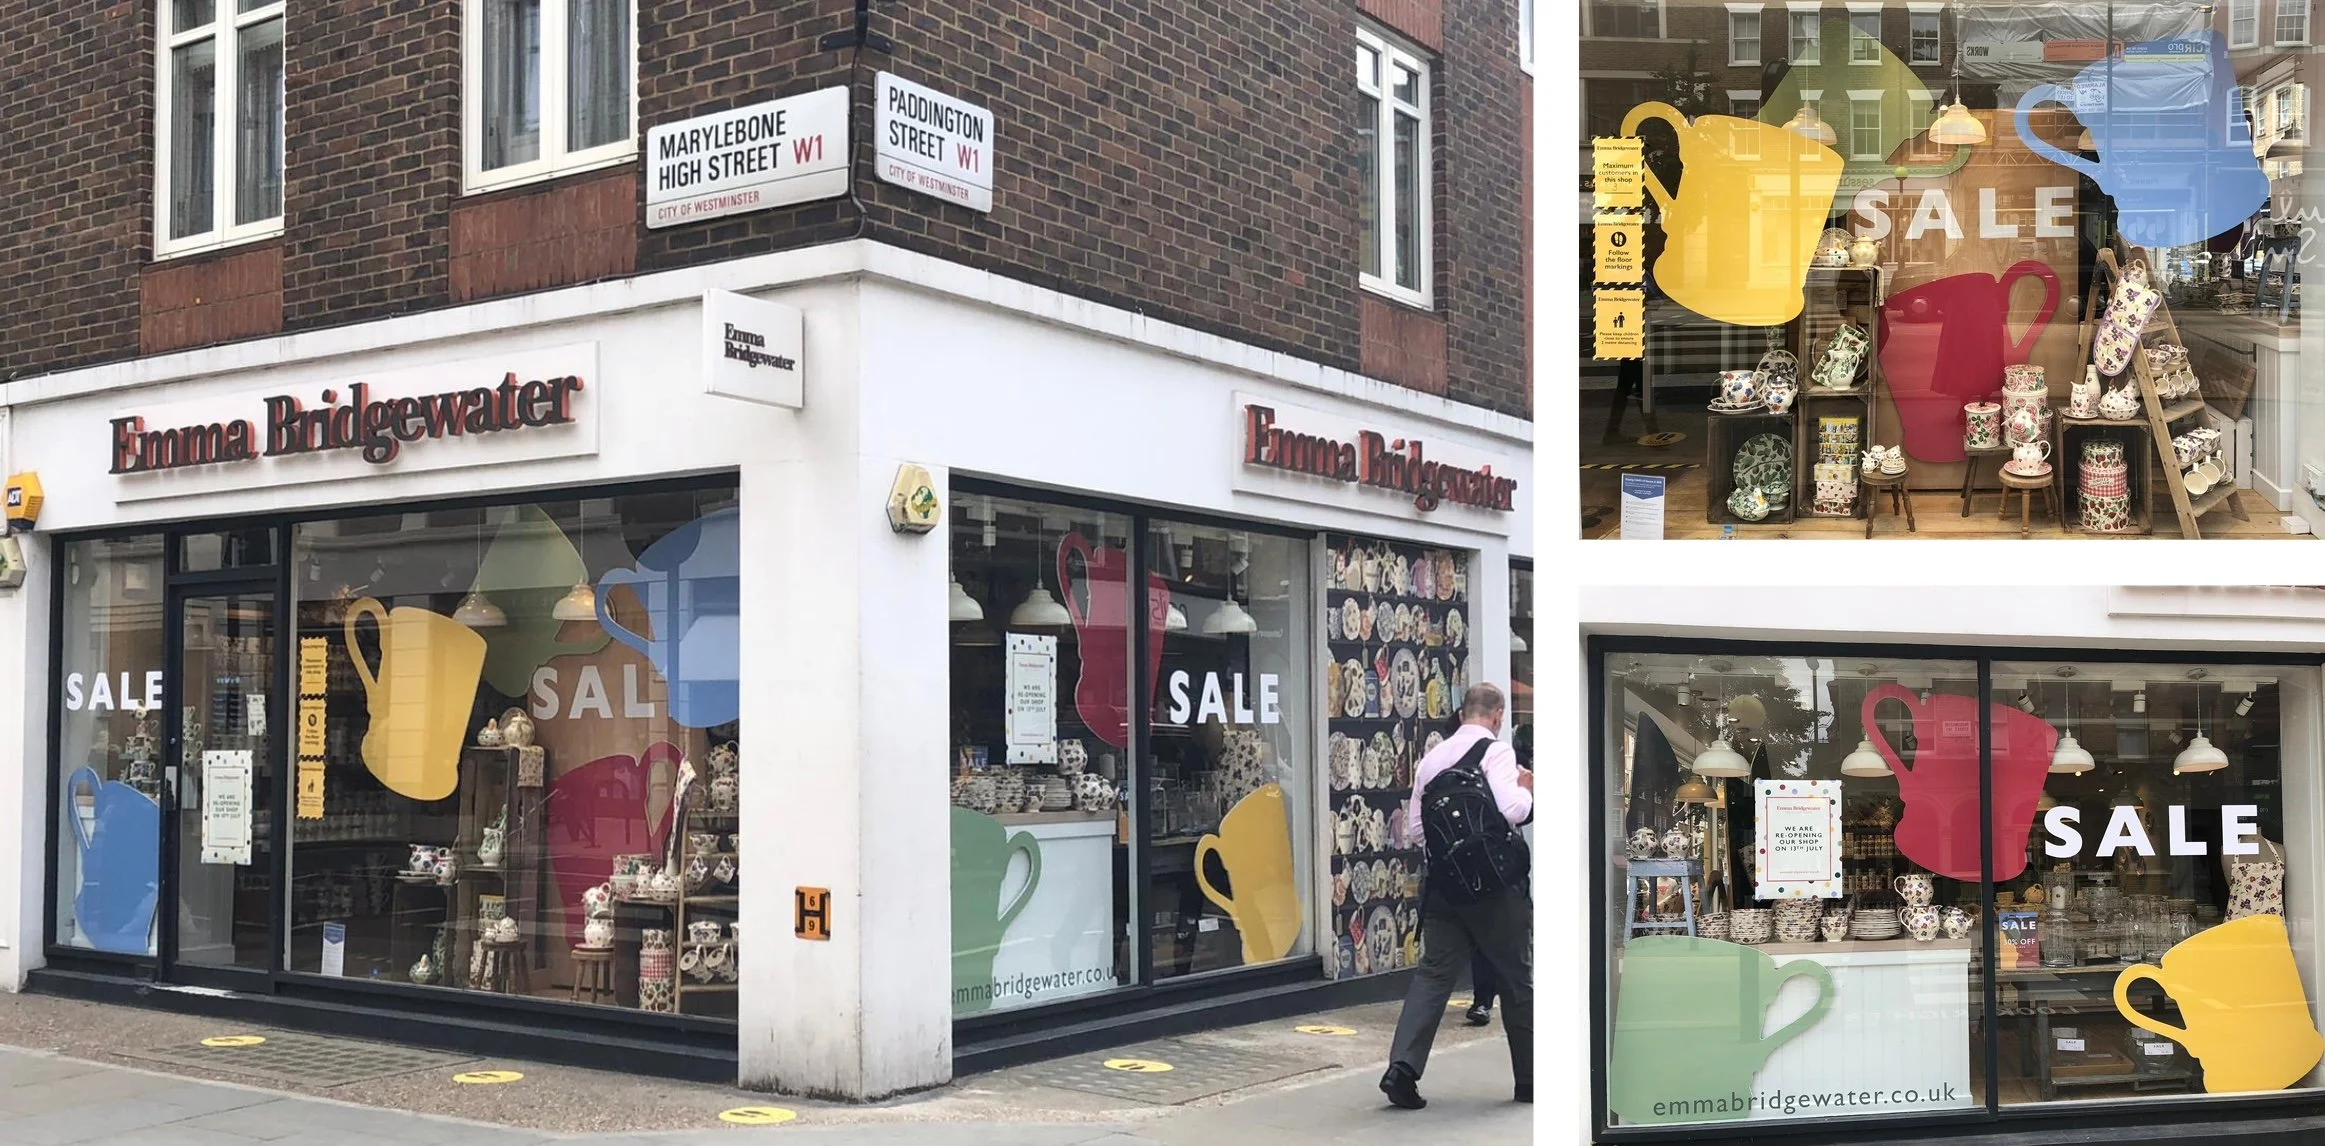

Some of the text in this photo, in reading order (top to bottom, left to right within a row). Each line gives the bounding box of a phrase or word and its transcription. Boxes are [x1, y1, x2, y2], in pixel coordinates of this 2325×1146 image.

[660, 110, 787, 161] MARYLEBONE
[889, 86, 983, 143] PADDINGTON
[659, 134, 823, 191] HIGH STREET W1
[889, 119, 979, 174] STREET W1
[658, 190, 760, 220] CITY OF WESTMINSTER
[889, 164, 969, 201] CITY OF WESTMINSTER
[1853, 186, 2075, 241] SALE
[724, 322, 765, 347] Emma
[724, 340, 795, 371] Bridgewater
[108, 372, 584, 474] Emma Bridgewater
[1243, 404, 1517, 512] Emma Bridgewater
[66, 670, 163, 711] SALE
[532, 664, 656, 720] SAL
[1169, 670, 1280, 724] SALE
[2044, 804, 2260, 858] SALE
[809, 920, 815, 931] 9
[810, 895, 816, 907] 6
[2002, 921, 2036, 930] SALE
[1653, 1082, 1956, 1116] emmabridgewater.co.uk
